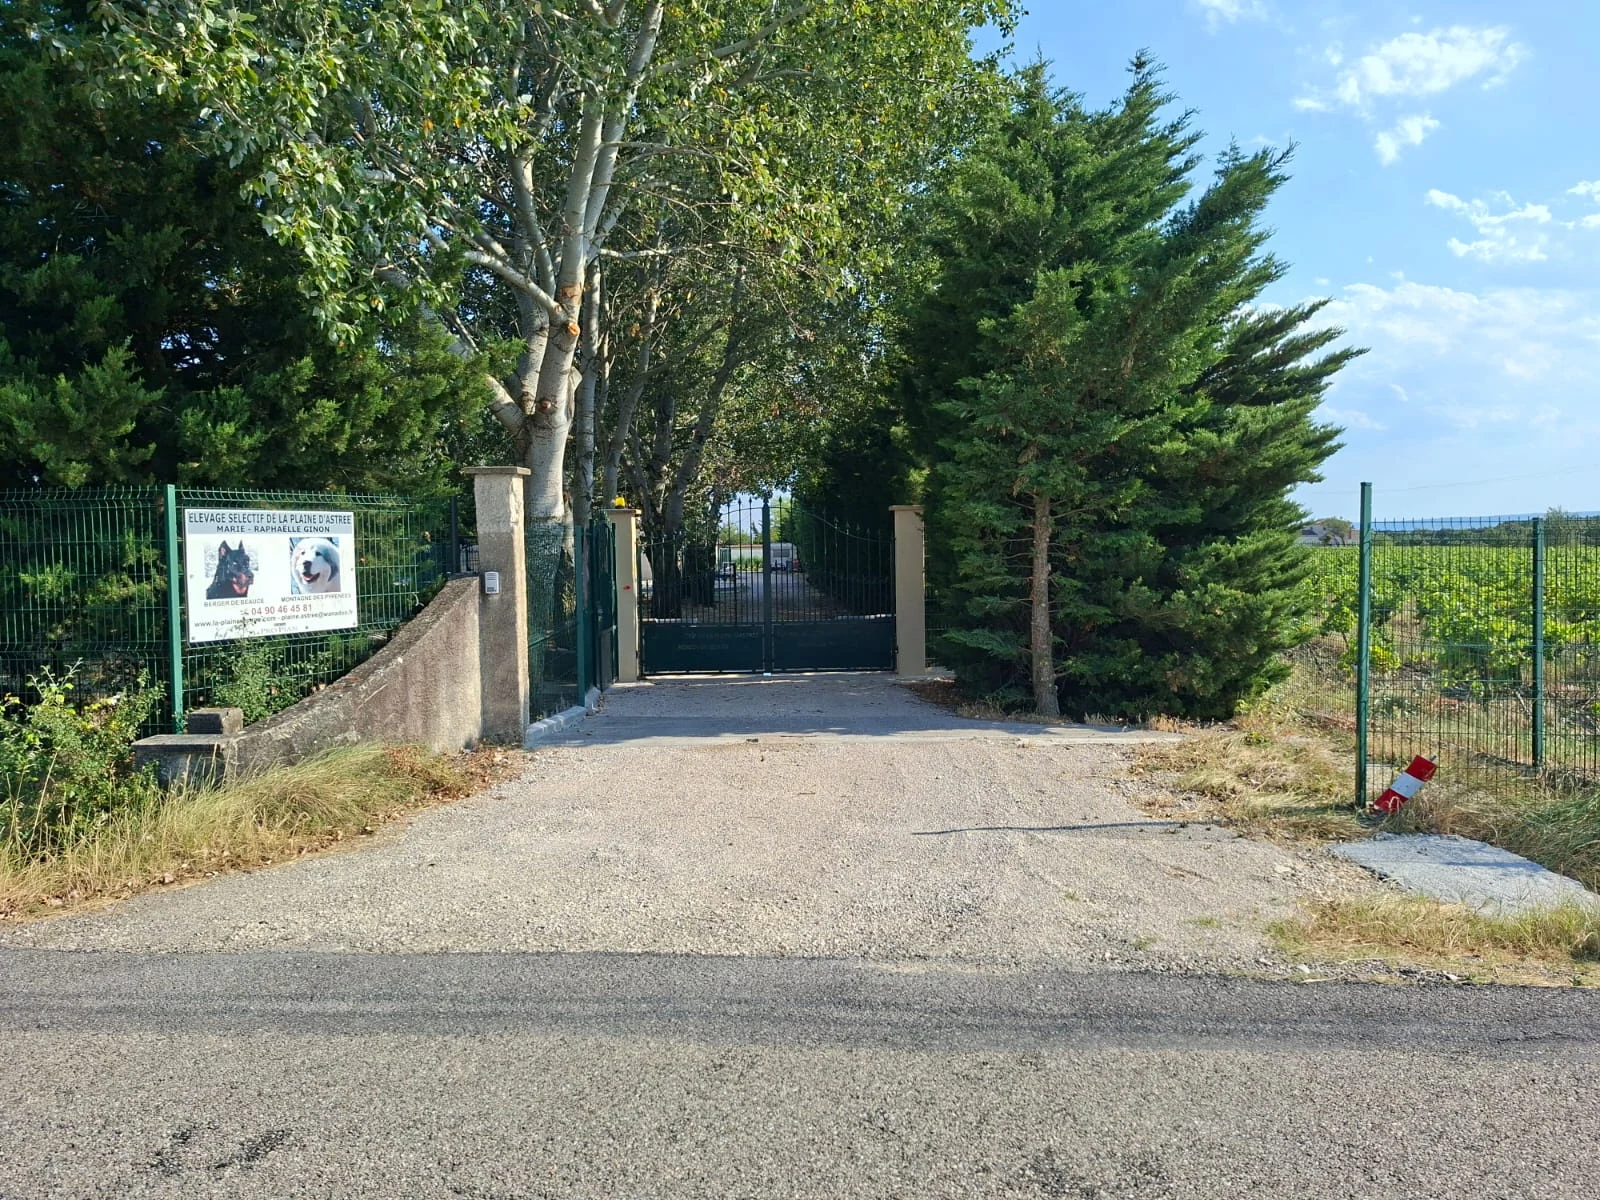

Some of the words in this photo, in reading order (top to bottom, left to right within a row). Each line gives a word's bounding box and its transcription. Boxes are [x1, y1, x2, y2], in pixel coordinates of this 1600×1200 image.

[228, 513, 265, 524] SELECTIF
[266, 513, 276, 524] DE
[278, 513, 288, 524] LA
[290, 514, 316, 524] PLAINE
[318, 514, 352, 525] D'ASTREE
[216, 525, 246, 533] MARIE
[303, 525, 330, 533] GINON
[203, 600, 230, 608] BERGER
[240, 598, 264, 606] BEAUCE
[280, 595, 312, 603] MONTAGNE
[251, 606, 262, 616] 04
[264, 606, 275, 615] 90
[277, 605, 288, 614] 46
[290, 604, 301, 613] 45
[302, 603, 312, 612] 81
